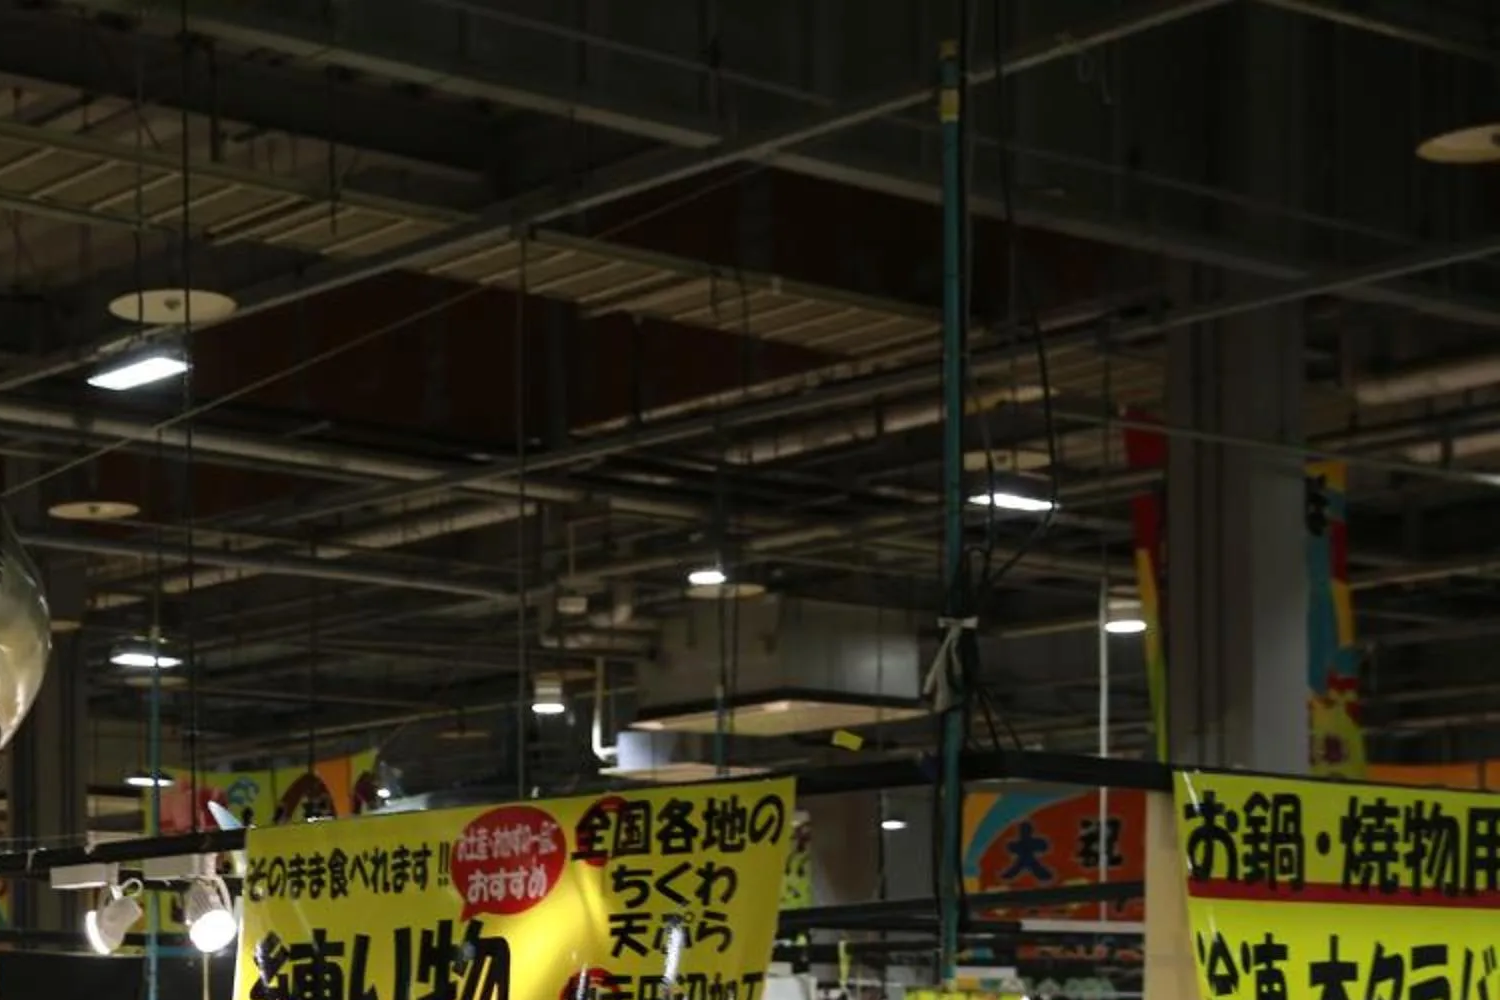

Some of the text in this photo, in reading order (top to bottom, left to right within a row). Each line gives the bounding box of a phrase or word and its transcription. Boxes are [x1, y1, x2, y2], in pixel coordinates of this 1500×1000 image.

[571, 793, 786, 862] 全国各地の
[1001, 818, 1055, 881] 大
[1183, 789, 1500, 898] お鍋・焼物用
[467, 860, 548, 905] おすすめ
[610, 860, 738, 910] ちくわ
[608, 909, 733, 958] 天ぷら
